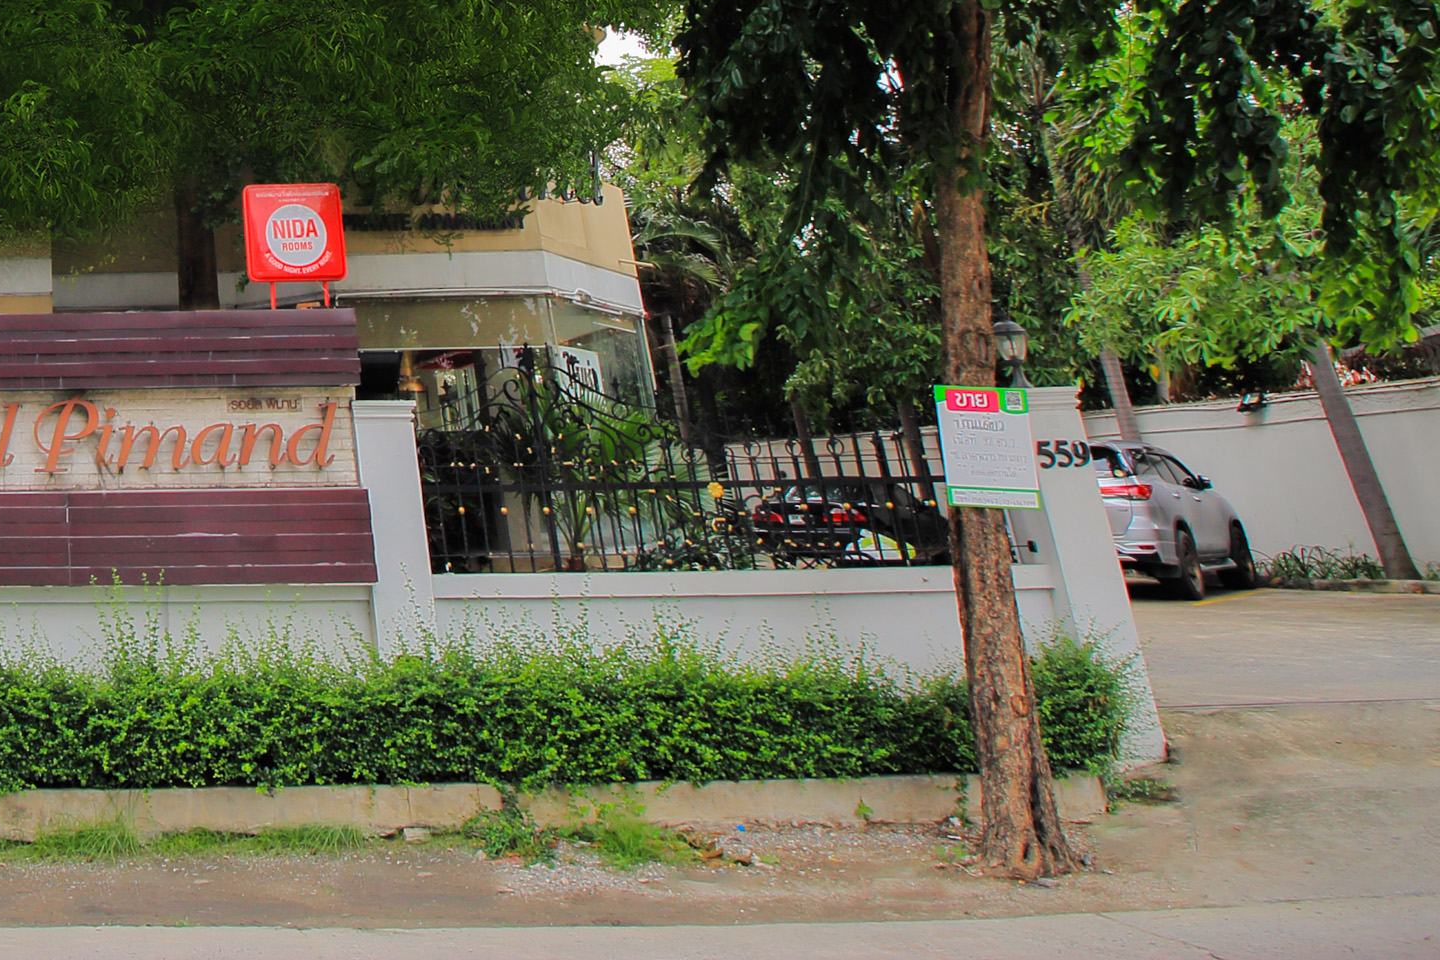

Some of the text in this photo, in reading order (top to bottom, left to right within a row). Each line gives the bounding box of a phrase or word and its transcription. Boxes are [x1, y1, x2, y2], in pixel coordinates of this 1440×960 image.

[272, 218, 318, 239] NIDA
[282, 241, 313, 251] ROOMS
[268, 257, 283, 270] GOOD
[302, 263, 320, 274] EVERY
[954, 392, 988, 408] ขาย
[33, 394, 337, 474] Pimand
[1036, 440, 1091, 469] 559
